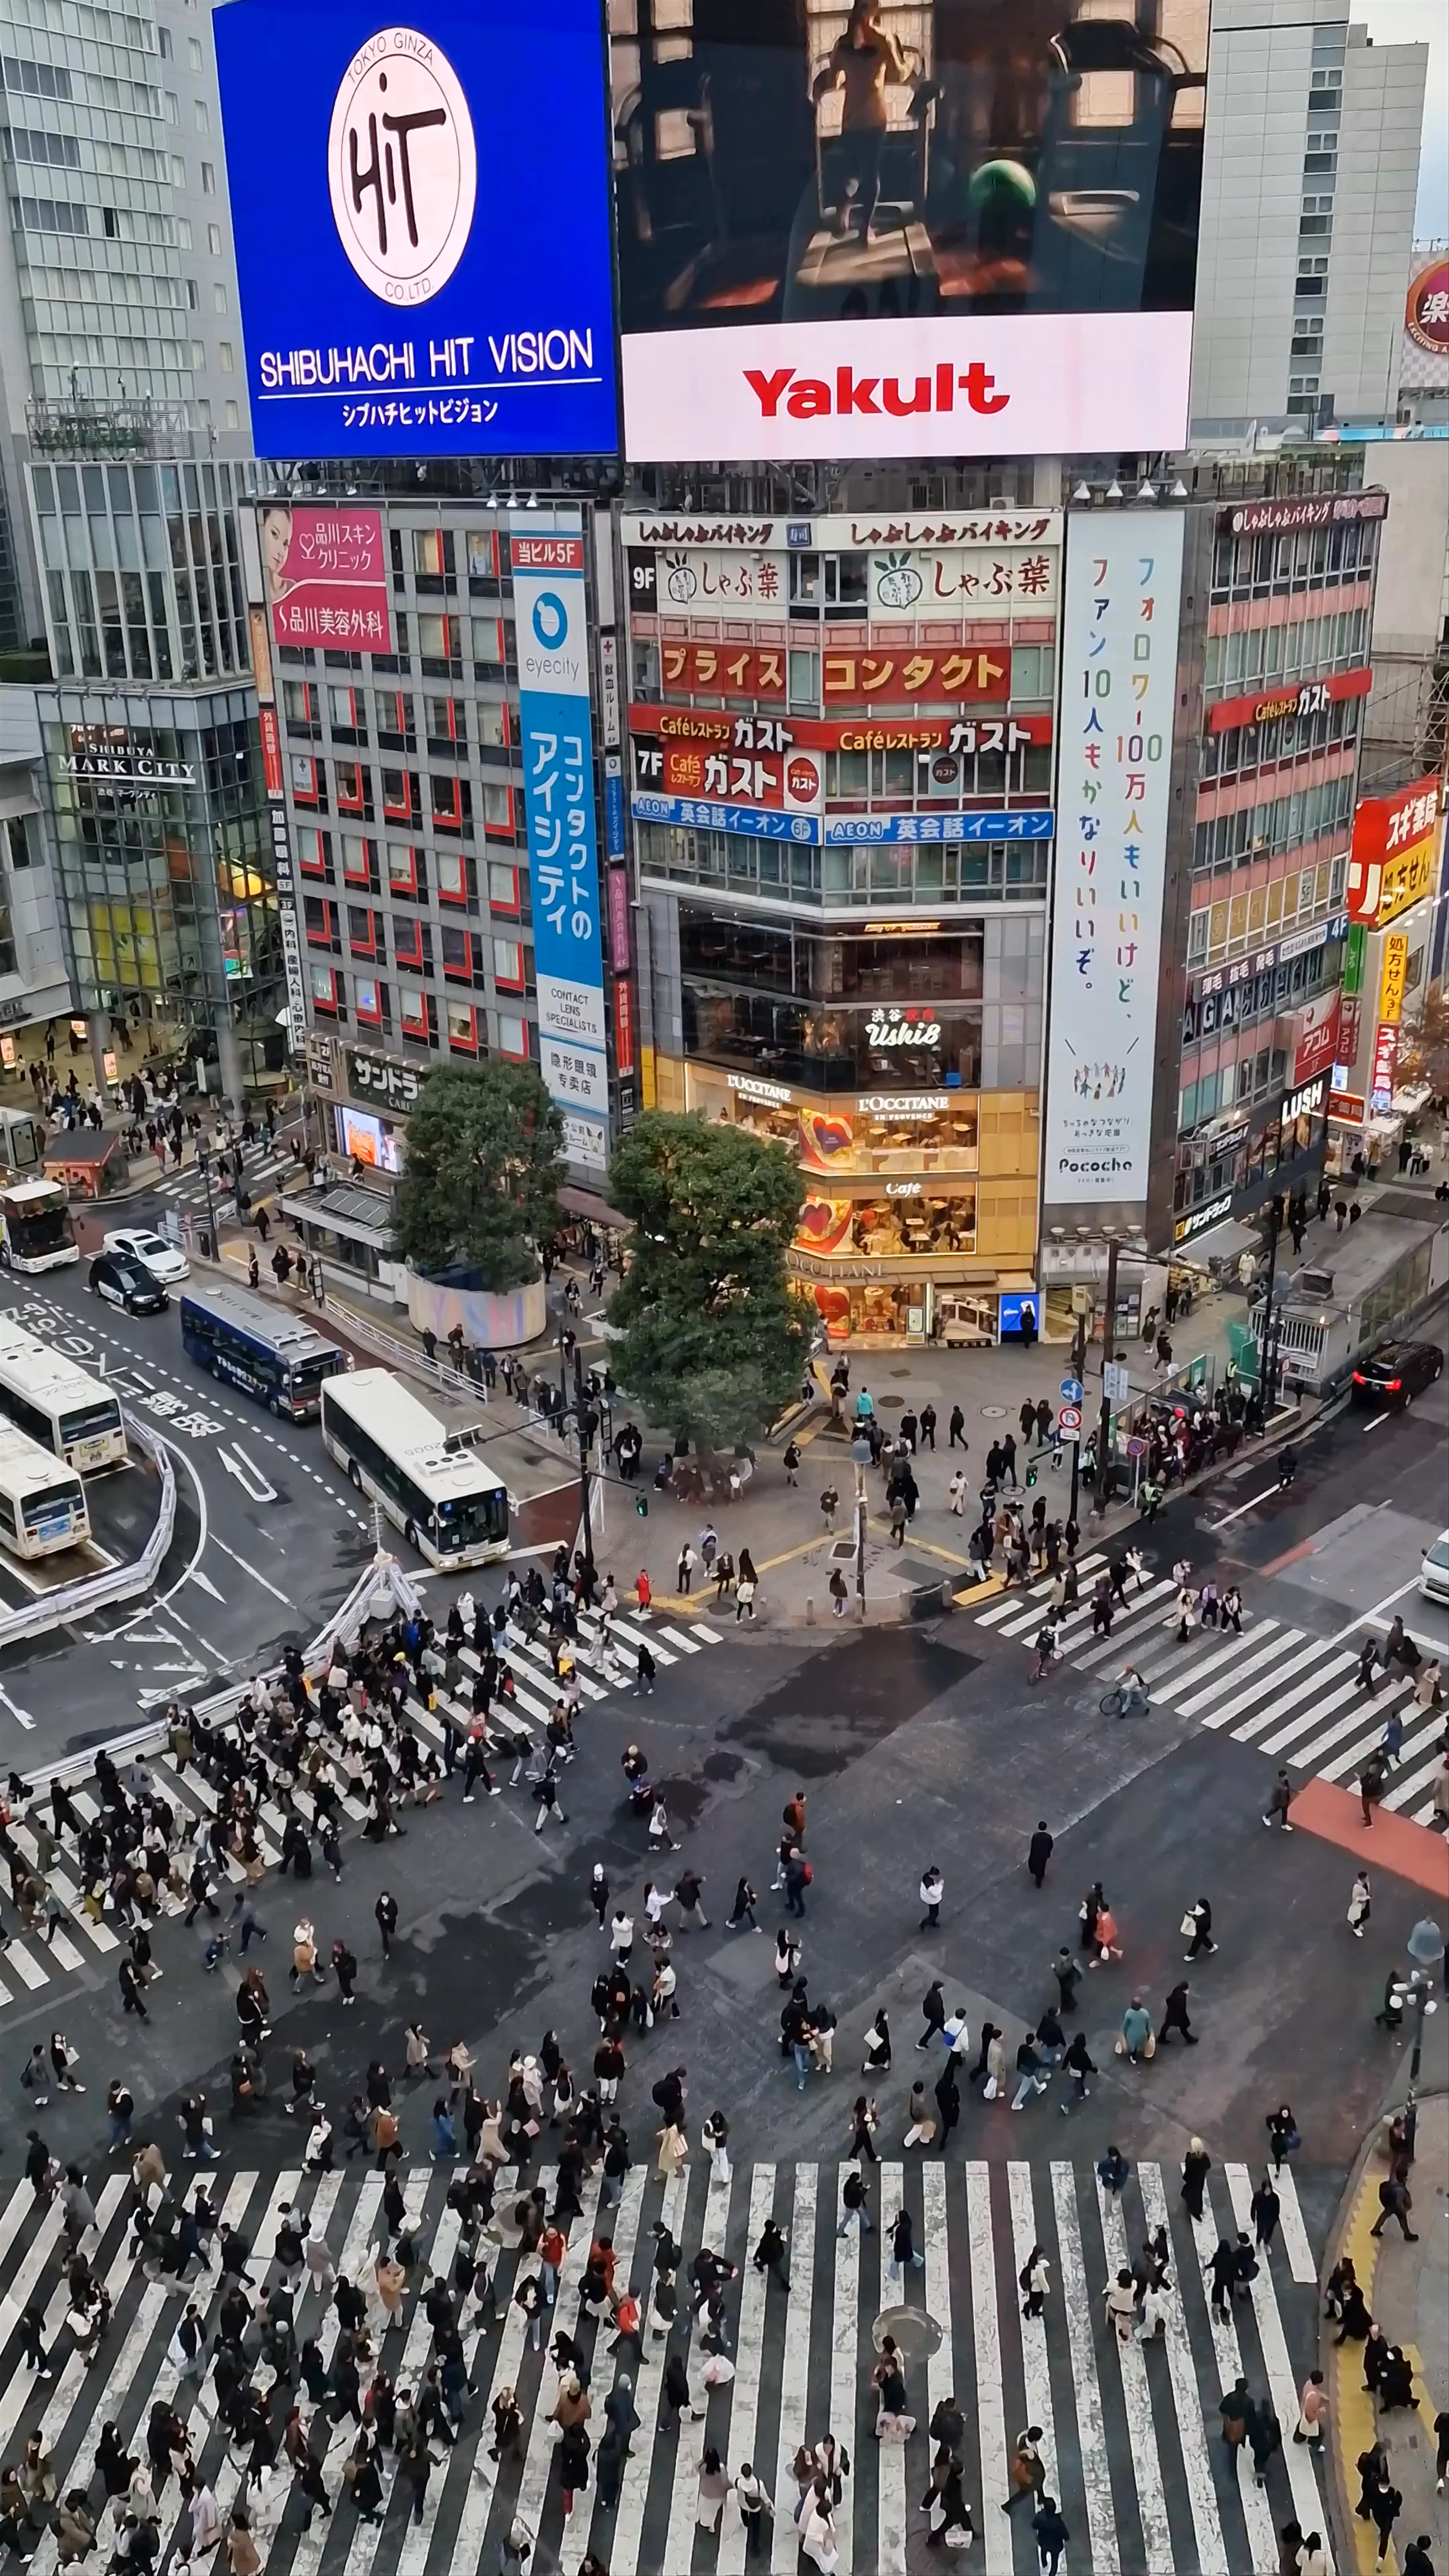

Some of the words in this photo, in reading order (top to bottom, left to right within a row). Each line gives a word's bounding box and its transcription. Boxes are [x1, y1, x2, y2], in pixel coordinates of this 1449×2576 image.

[347, 35, 387, 83] TOKYO
[394, 32, 434, 66] GINZA
[1407, 321, 1439, 353] EXCITING
[1441, 345, 1449, 354] A
[260, 342, 415, 388] SHIBUHACHI
[430, 337, 473, 377] HIT
[488, 328, 592, 373] VISION
[743, 362, 1011, 418] Yakult
[343, 400, 498, 427] シブハチヒットビジョン
[1244, 500, 1331, 531] しゃぶしゃぶバイキング
[315, 523, 375, 544] 品川スキン
[639, 521, 773, 543] しゃぶしゃぶバイキング
[852, 518, 1050, 544] しゃぶしゃぶバイキング
[317, 549, 371, 571] クリニック
[518, 541, 575, 564] 当ビル5F
[633, 567, 655, 589] 9F
[703, 561, 779, 600] しゃぶ葉
[934, 555, 1050, 597] しゃぶ葉
[289, 606, 384, 640] 品川美容外科
[526, 657, 579, 681] eyecity
[664, 648, 783, 688] プライス
[825, 655, 1003, 690] コンタクト
[1297, 683, 1331, 717] ガスト
[735, 718, 794, 752] ガスト
[949, 721, 1031, 754] ガスト
[89, 743, 154, 757] SHIBUYA
[57, 755, 127, 774] MARK
[137, 760, 194, 778] CITY
[638, 751, 663, 776] 7F
[670, 754, 701, 774] Café
[935, 768, 956, 777] ガスト
[671, 774, 702, 787] レストラン
[704, 754, 777, 799] ガスト
[791, 777, 817, 792] ガスト
[636, 797, 671, 817] AEON
[680, 802, 785, 834] 英会話イーオン
[530, 732, 566, 934] アイシティ
[794, 823, 809, 836] 6F
[831, 821, 884, 840] AEON
[897, 815, 1049, 840] 英会話イーオン
[1386, 790, 1438, 851] スギ薬局
[563, 736, 592, 940] コンタクトの
[281, 900, 292, 909] 3F
[285, 929, 296, 949] 内科
[1331, 914, 1348, 939] 4F
[1386, 936, 1404, 997] 処方せん
[551, 988, 588, 1006] CONTACT
[545, 1012, 597, 1034] SPECIALISTS
[560, 1004, 581, 1017] LENS
[1304, 1026, 1330, 1058] アコム
[558, 1073, 592, 1095] 专卖店
[726, 1074, 791, 1102] L'OCCITANE
[858, 1096, 949, 1112] L'OCCITANE
[1282, 1080, 1323, 1126] LUSH
[1059, 1157, 1132, 1173] Pococha
[1192, 1195, 1232, 1230] サンドラッグ
